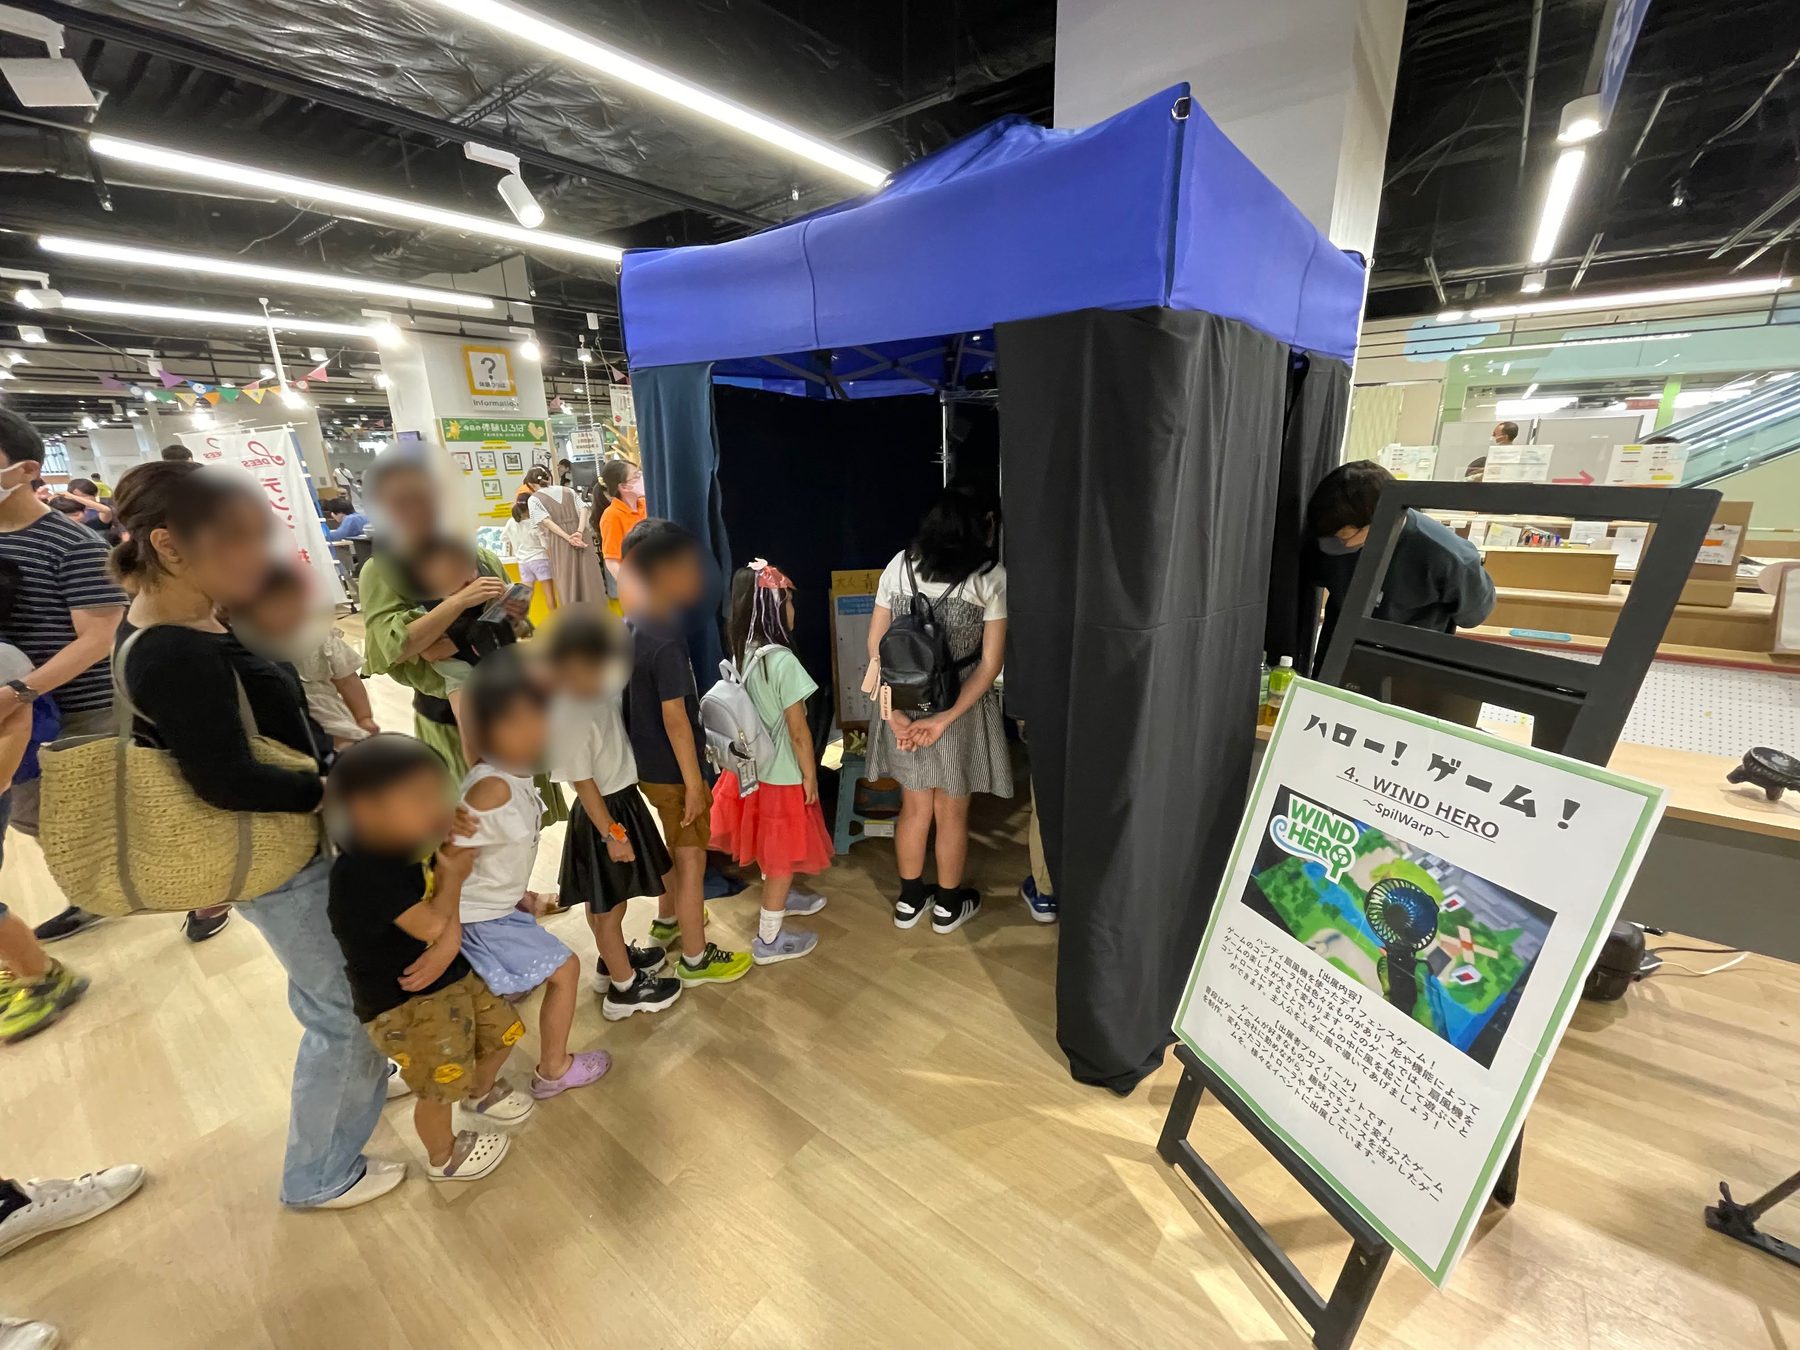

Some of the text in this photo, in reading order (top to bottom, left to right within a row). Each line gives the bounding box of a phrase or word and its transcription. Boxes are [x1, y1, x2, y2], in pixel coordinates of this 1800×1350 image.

[1291, 798, 1355, 844] WIND
[1341, 767, 1499, 838] 4. WIND HERO
[1318, 968, 1362, 1004] 【出展内容】
